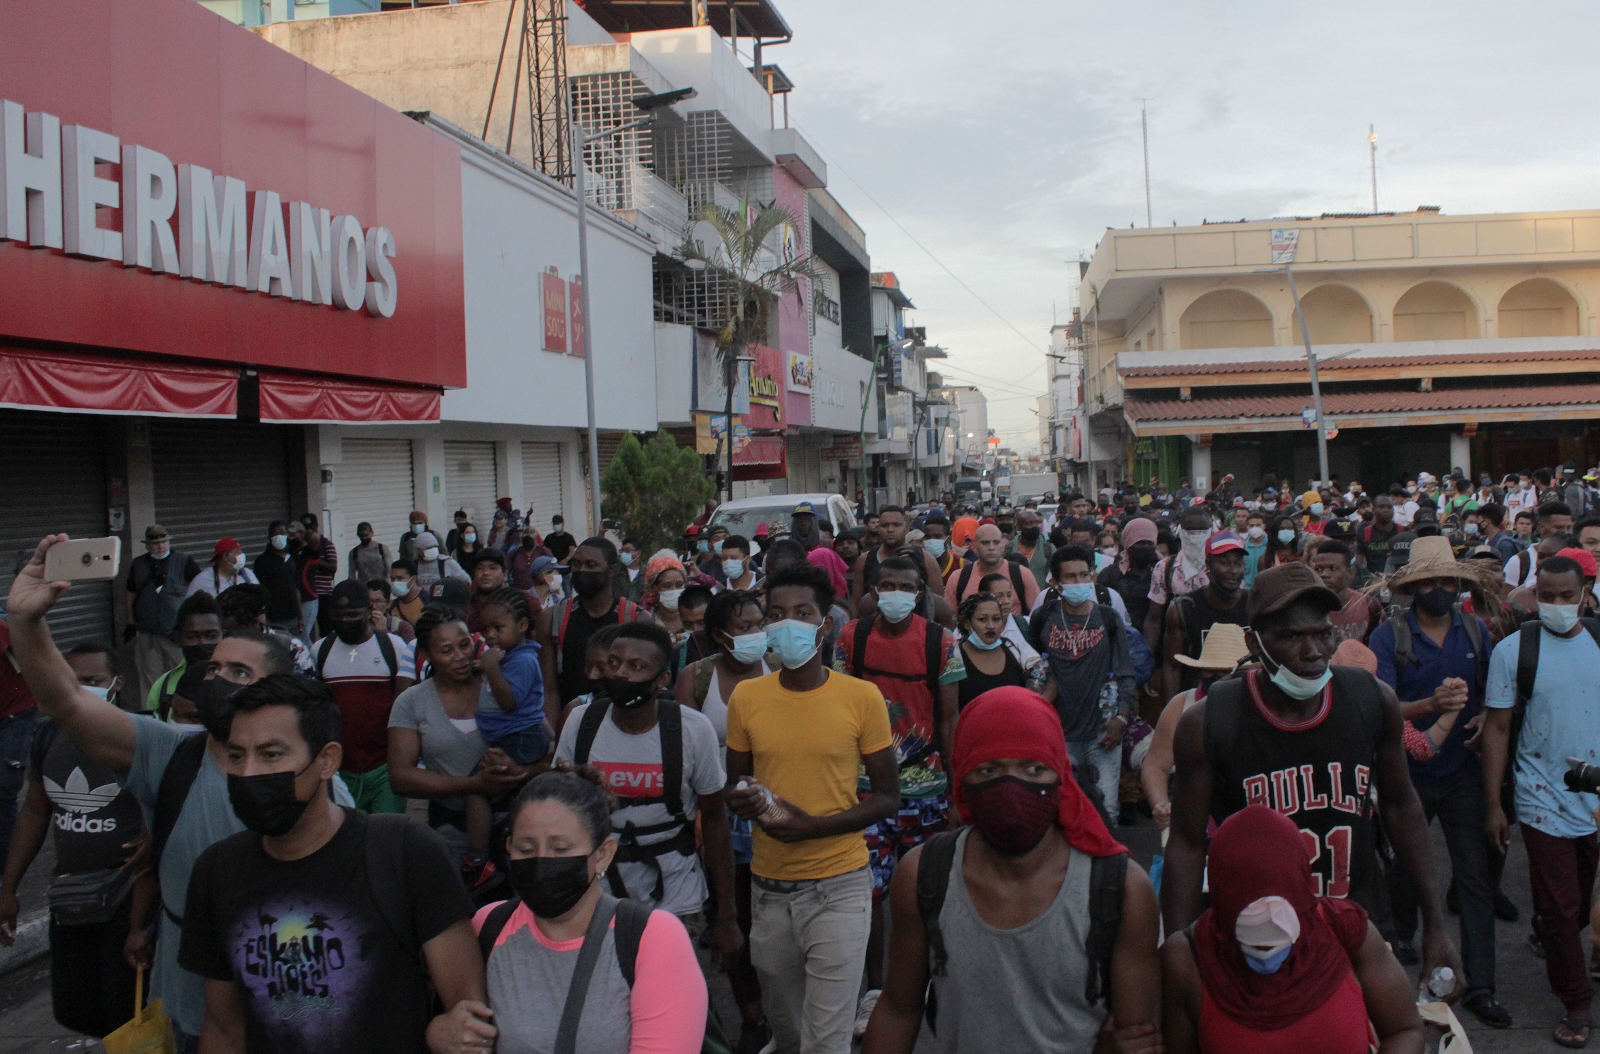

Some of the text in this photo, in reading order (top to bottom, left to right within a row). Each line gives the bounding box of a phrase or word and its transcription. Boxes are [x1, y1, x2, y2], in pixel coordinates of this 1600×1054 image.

[0, 99, 398, 317] HERMANOS
[545, 290, 564, 312] MINI
[1243, 762, 1370, 816] BULLS
